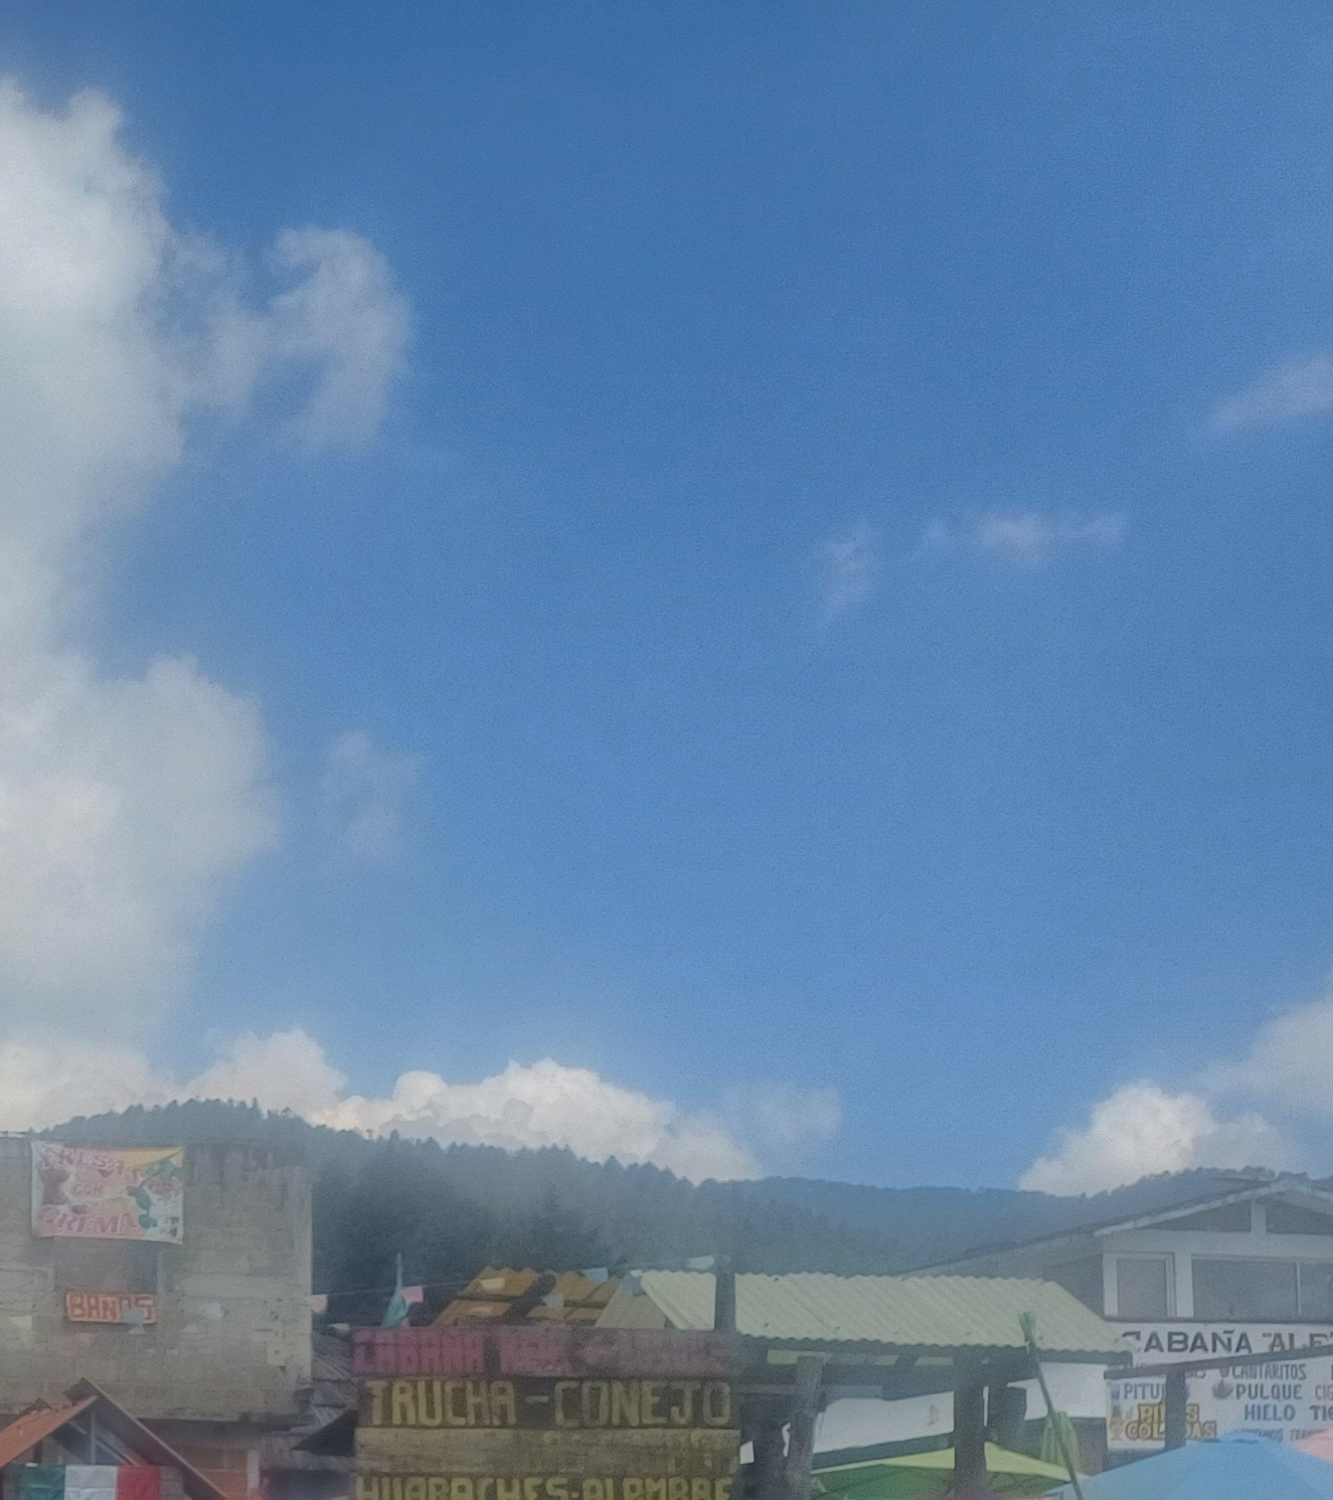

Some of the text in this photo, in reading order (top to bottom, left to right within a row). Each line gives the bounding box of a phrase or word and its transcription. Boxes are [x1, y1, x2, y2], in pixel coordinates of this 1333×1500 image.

[1236, 1384, 1303, 1400] PULQUE
[365, 1379, 517, 1427] TRUCHA
[553, 1379, 732, 1429] CONEJO
[1244, 1404, 1297, 1421] HIELO
